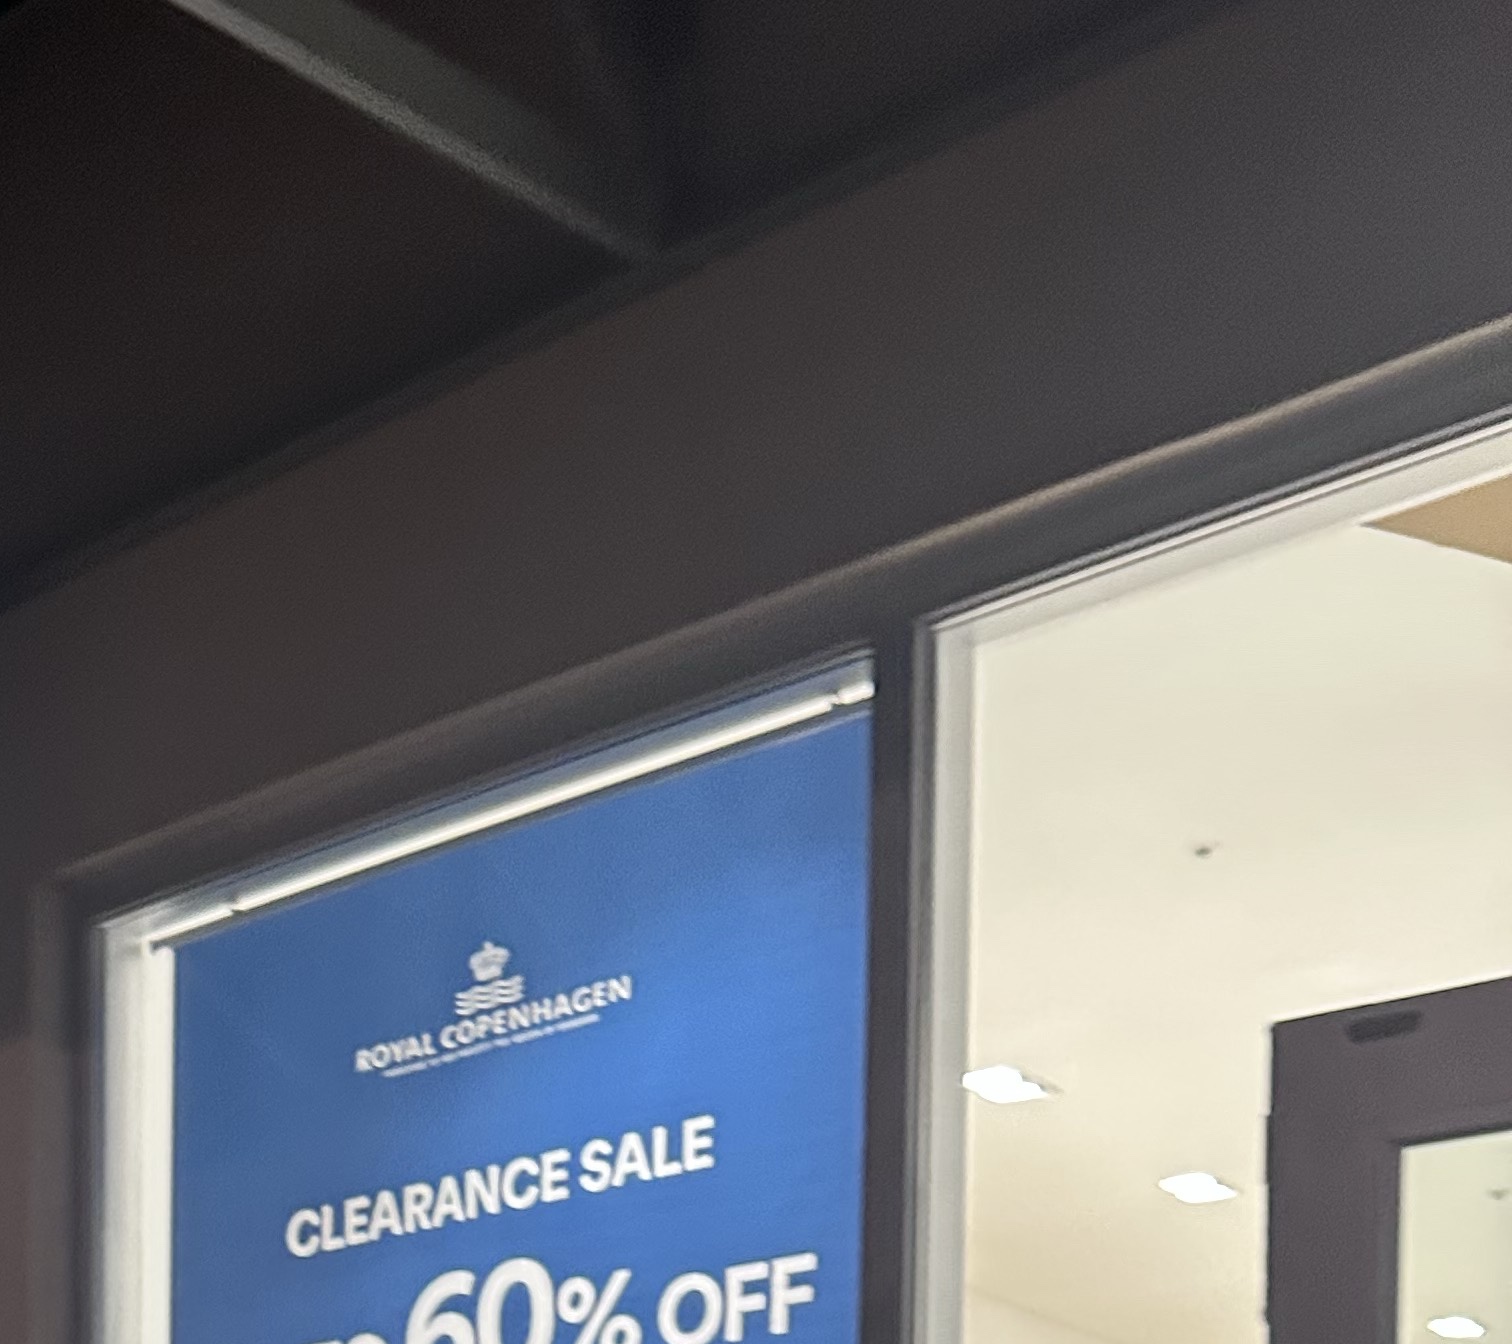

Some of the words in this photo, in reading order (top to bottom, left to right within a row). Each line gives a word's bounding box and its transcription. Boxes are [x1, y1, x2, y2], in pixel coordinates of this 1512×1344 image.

[354, 1031, 437, 1073] ROYAL
[439, 975, 633, 1049] COPENHAGEN
[286, 1148, 571, 1258] CLEARANCE
[578, 1115, 716, 1194] SALE
